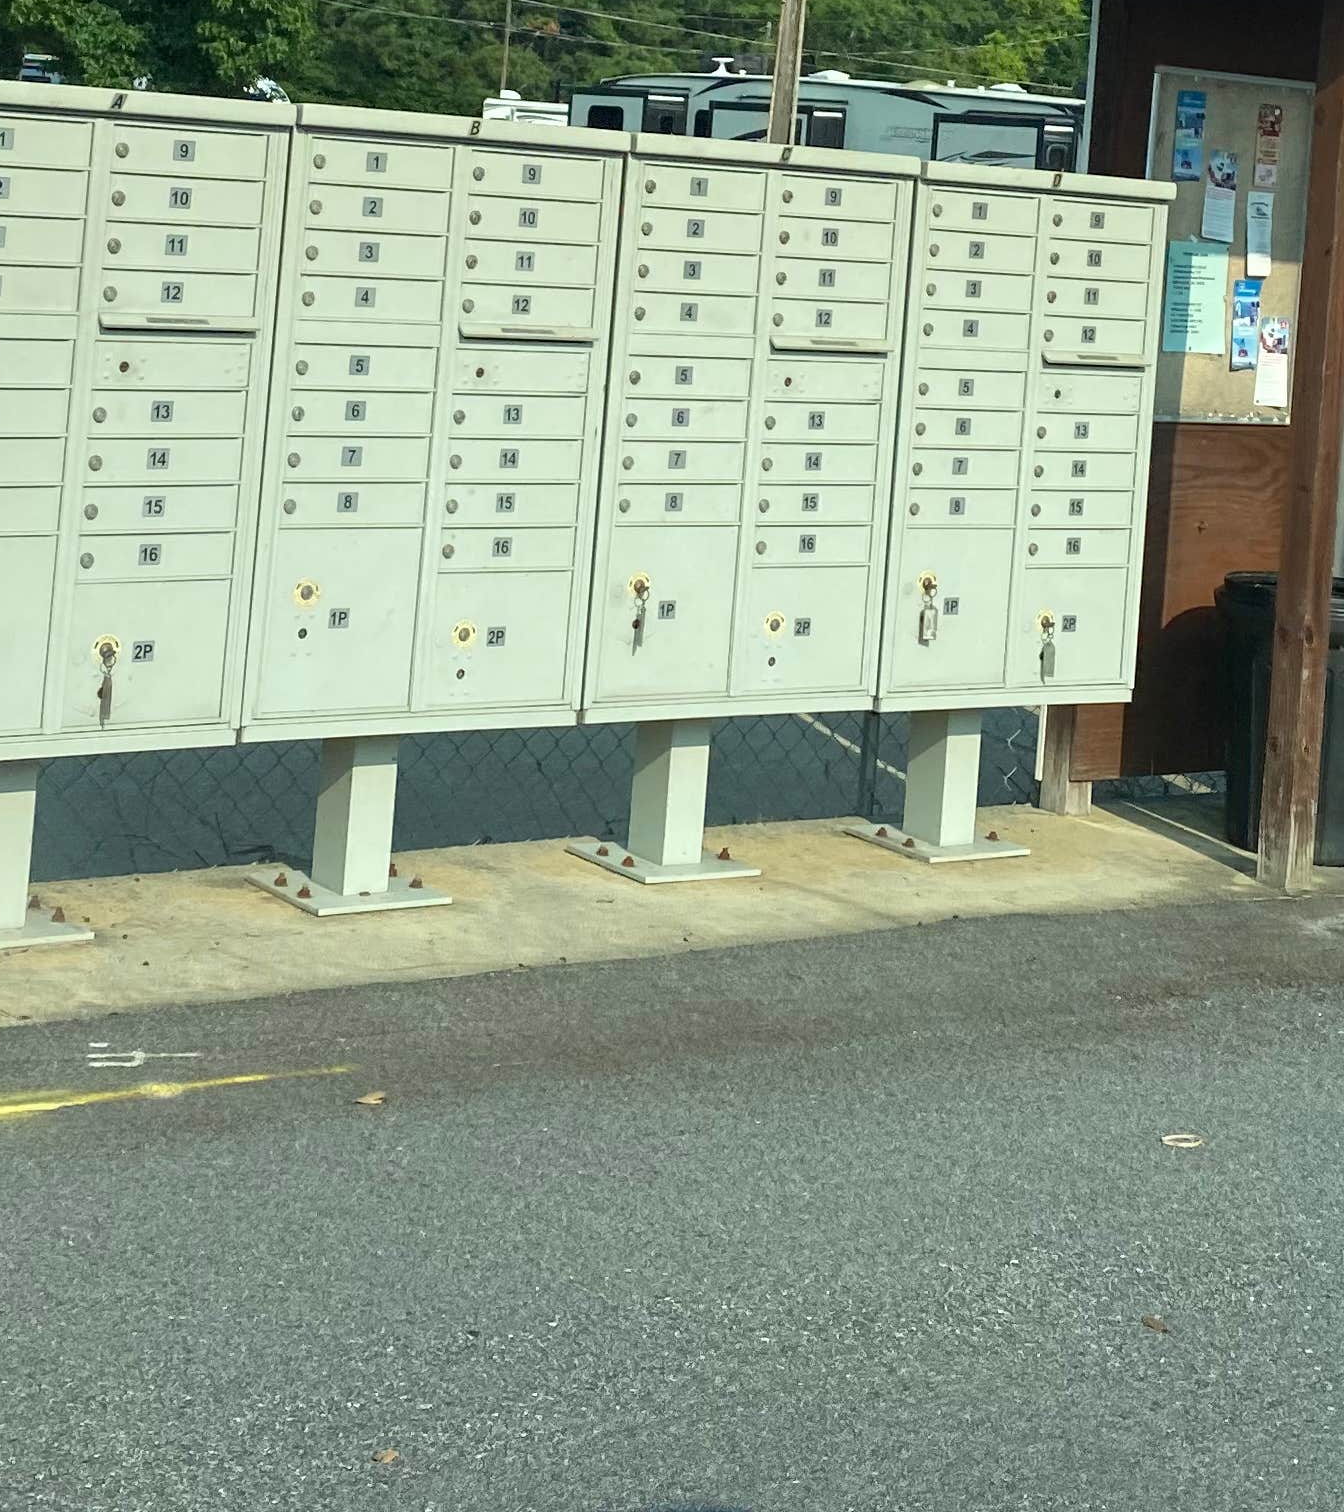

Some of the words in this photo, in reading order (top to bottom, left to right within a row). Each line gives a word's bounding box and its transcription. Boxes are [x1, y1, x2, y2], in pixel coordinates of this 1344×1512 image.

[111, 95, 124, 109] A
[469, 121, 481, 135] B
[179, 144, 189, 157] 9
[528, 168, 537, 180] 9
[171, 191, 189, 205] 10
[368, 201, 377, 214] 2
[521, 211, 536, 224] 10
[824, 232, 838, 243] 10
[168, 238, 184, 252] 11
[364, 245, 374, 259] 3
[518, 256, 532, 268] 11
[1088, 253, 1101, 266] 10
[821, 272, 833, 284] 11
[163, 286, 181, 299] 12
[360, 290, 370, 304] 4
[1087, 290, 1097, 302] 11
[514, 299, 529, 312] 12
[818, 312, 831, 324] 12
[1082, 329, 1095, 340] 12
[355, 359, 365, 372] 5
[153, 405, 170, 418] 13
[351, 404, 360, 417] 6
[506, 408, 520, 421] 13
[809, 415, 823, 426] 13
[1075, 425, 1088, 436] 13
[150, 452, 167, 466] 14
[348, 450, 357, 463] 7
[502, 453, 516, 465] 14
[807, 456, 819, 467] 14
[1073, 463, 1085, 474] 14
[145, 500, 163, 514] 15
[343, 495, 353, 509] 8
[499, 496, 513, 509] 15
[803, 497, 817, 509] 15
[1070, 502, 1082, 513] 15
[494, 541, 509, 553] 16
[801, 537, 814, 549] 16
[1067, 541, 1080, 552] 16
[141, 548, 158, 561] 16
[660, 604, 675, 616] 1P
[944, 601, 958, 612] 1P
[330, 612, 348, 625] 1P
[1062, 618, 1077, 630] 2P
[795, 622, 811, 634] 2P
[487, 631, 505, 644] 2P
[133, 645, 153, 659] 2P
